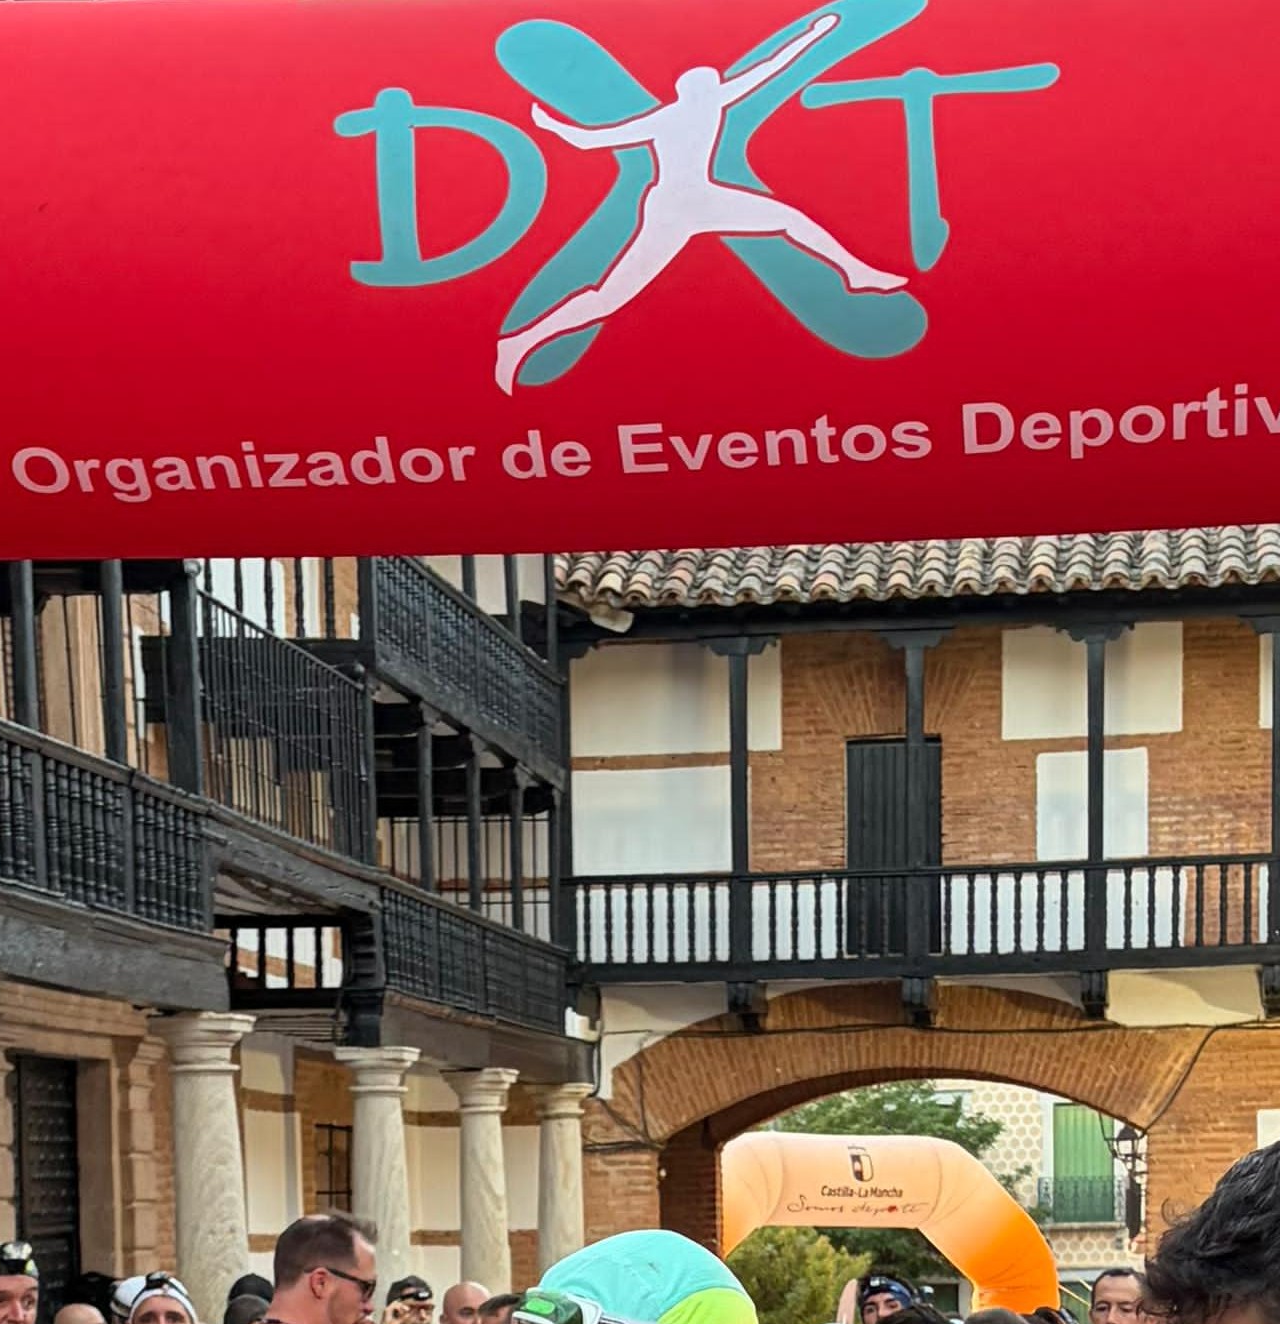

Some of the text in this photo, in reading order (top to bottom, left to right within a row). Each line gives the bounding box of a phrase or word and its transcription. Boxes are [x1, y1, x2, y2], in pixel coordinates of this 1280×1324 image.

[11, 442, 475, 504] Organizador
[502, 428, 592, 480] de
[620, 416, 932, 475] Eventos
